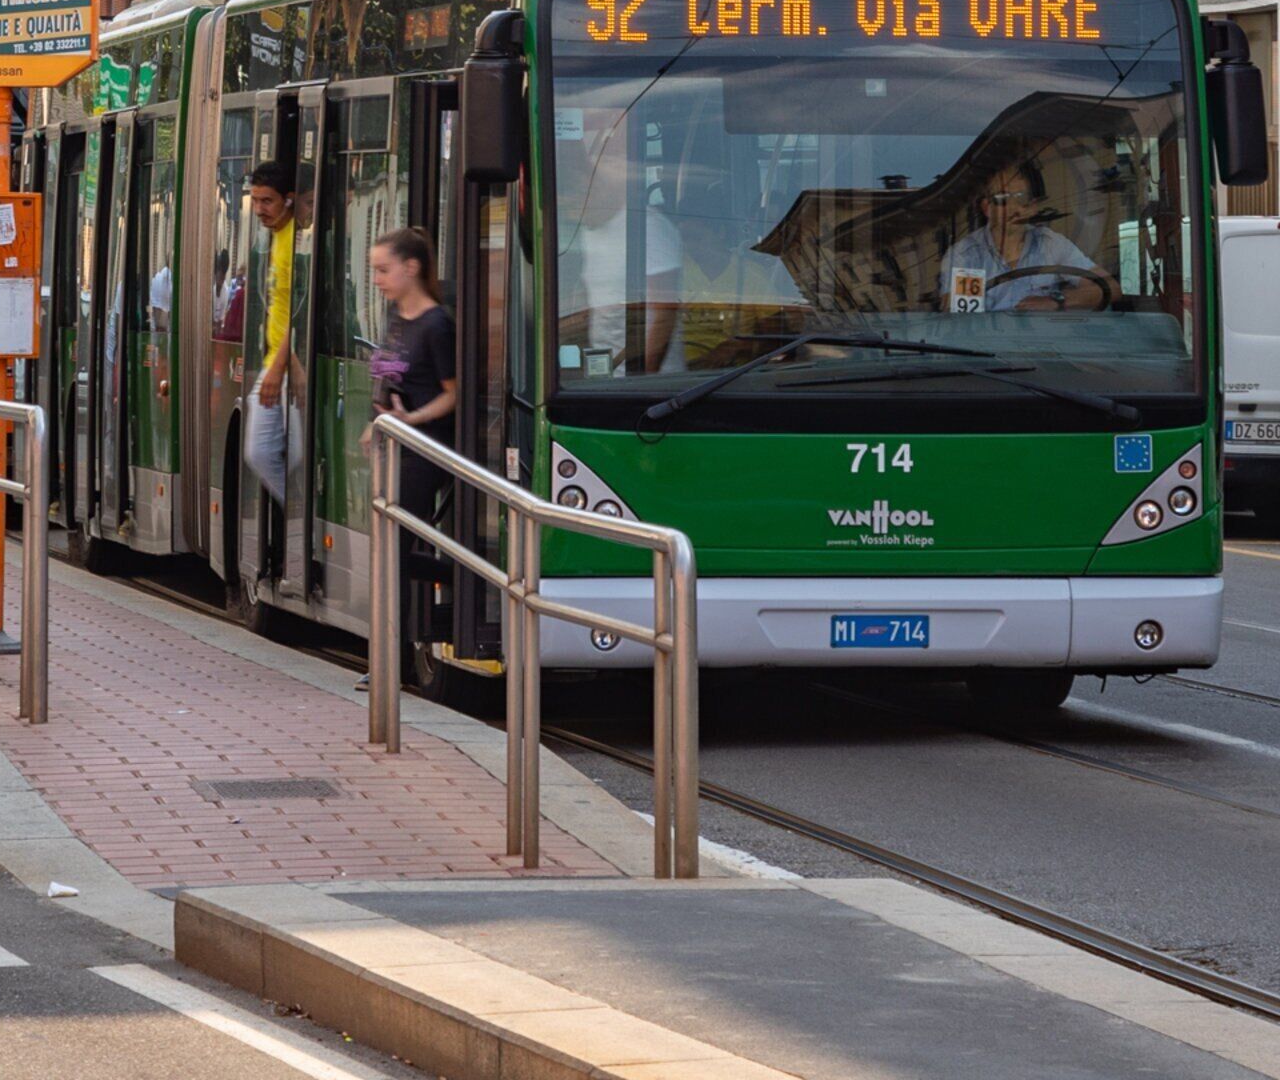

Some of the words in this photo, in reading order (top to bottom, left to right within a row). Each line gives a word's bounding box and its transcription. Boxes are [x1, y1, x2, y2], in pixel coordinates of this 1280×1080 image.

[14, 19, 21, 36] E
[26, 10, 82, 38] QUALITÀ
[29, 42, 43, 52] +39
[958, 277, 981, 295] 16
[957, 298, 980, 312] 92
[847, 443, 914, 474] 714
[860, 534, 901, 545] Vossloh
[904, 534, 935, 547] Kiepe
[835, 621, 856, 641] MI
[889, 621, 926, 641] 714
